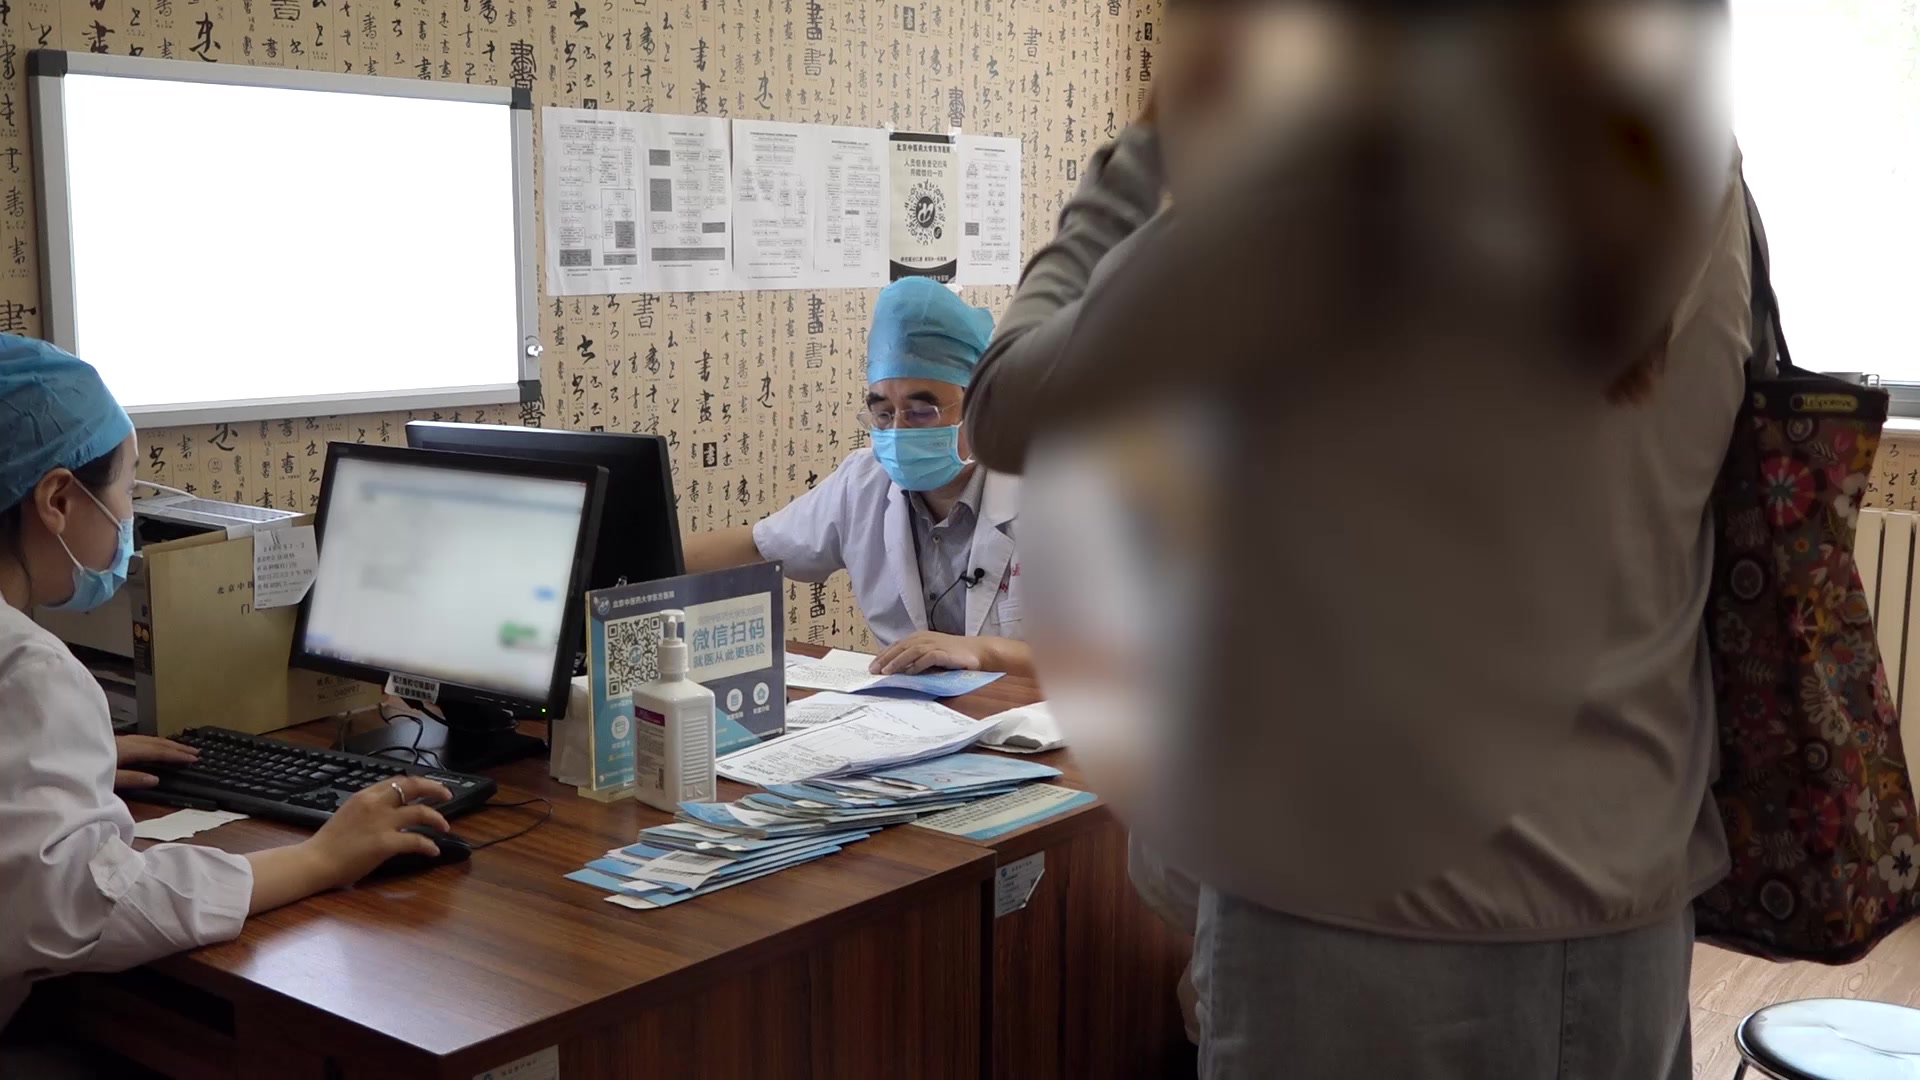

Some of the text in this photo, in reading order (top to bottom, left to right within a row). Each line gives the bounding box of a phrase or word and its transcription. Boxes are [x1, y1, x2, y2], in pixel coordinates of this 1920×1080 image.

[1023, 26, 1042, 57] 書
[804, 48, 826, 76] 書
[632, 292, 660, 329] 書
[612, 591, 675, 608] 北京中医药大学东方医院
[692, 617, 766, 653] 微信扫码
[693, 642, 766, 669] 就医从此更轻松
